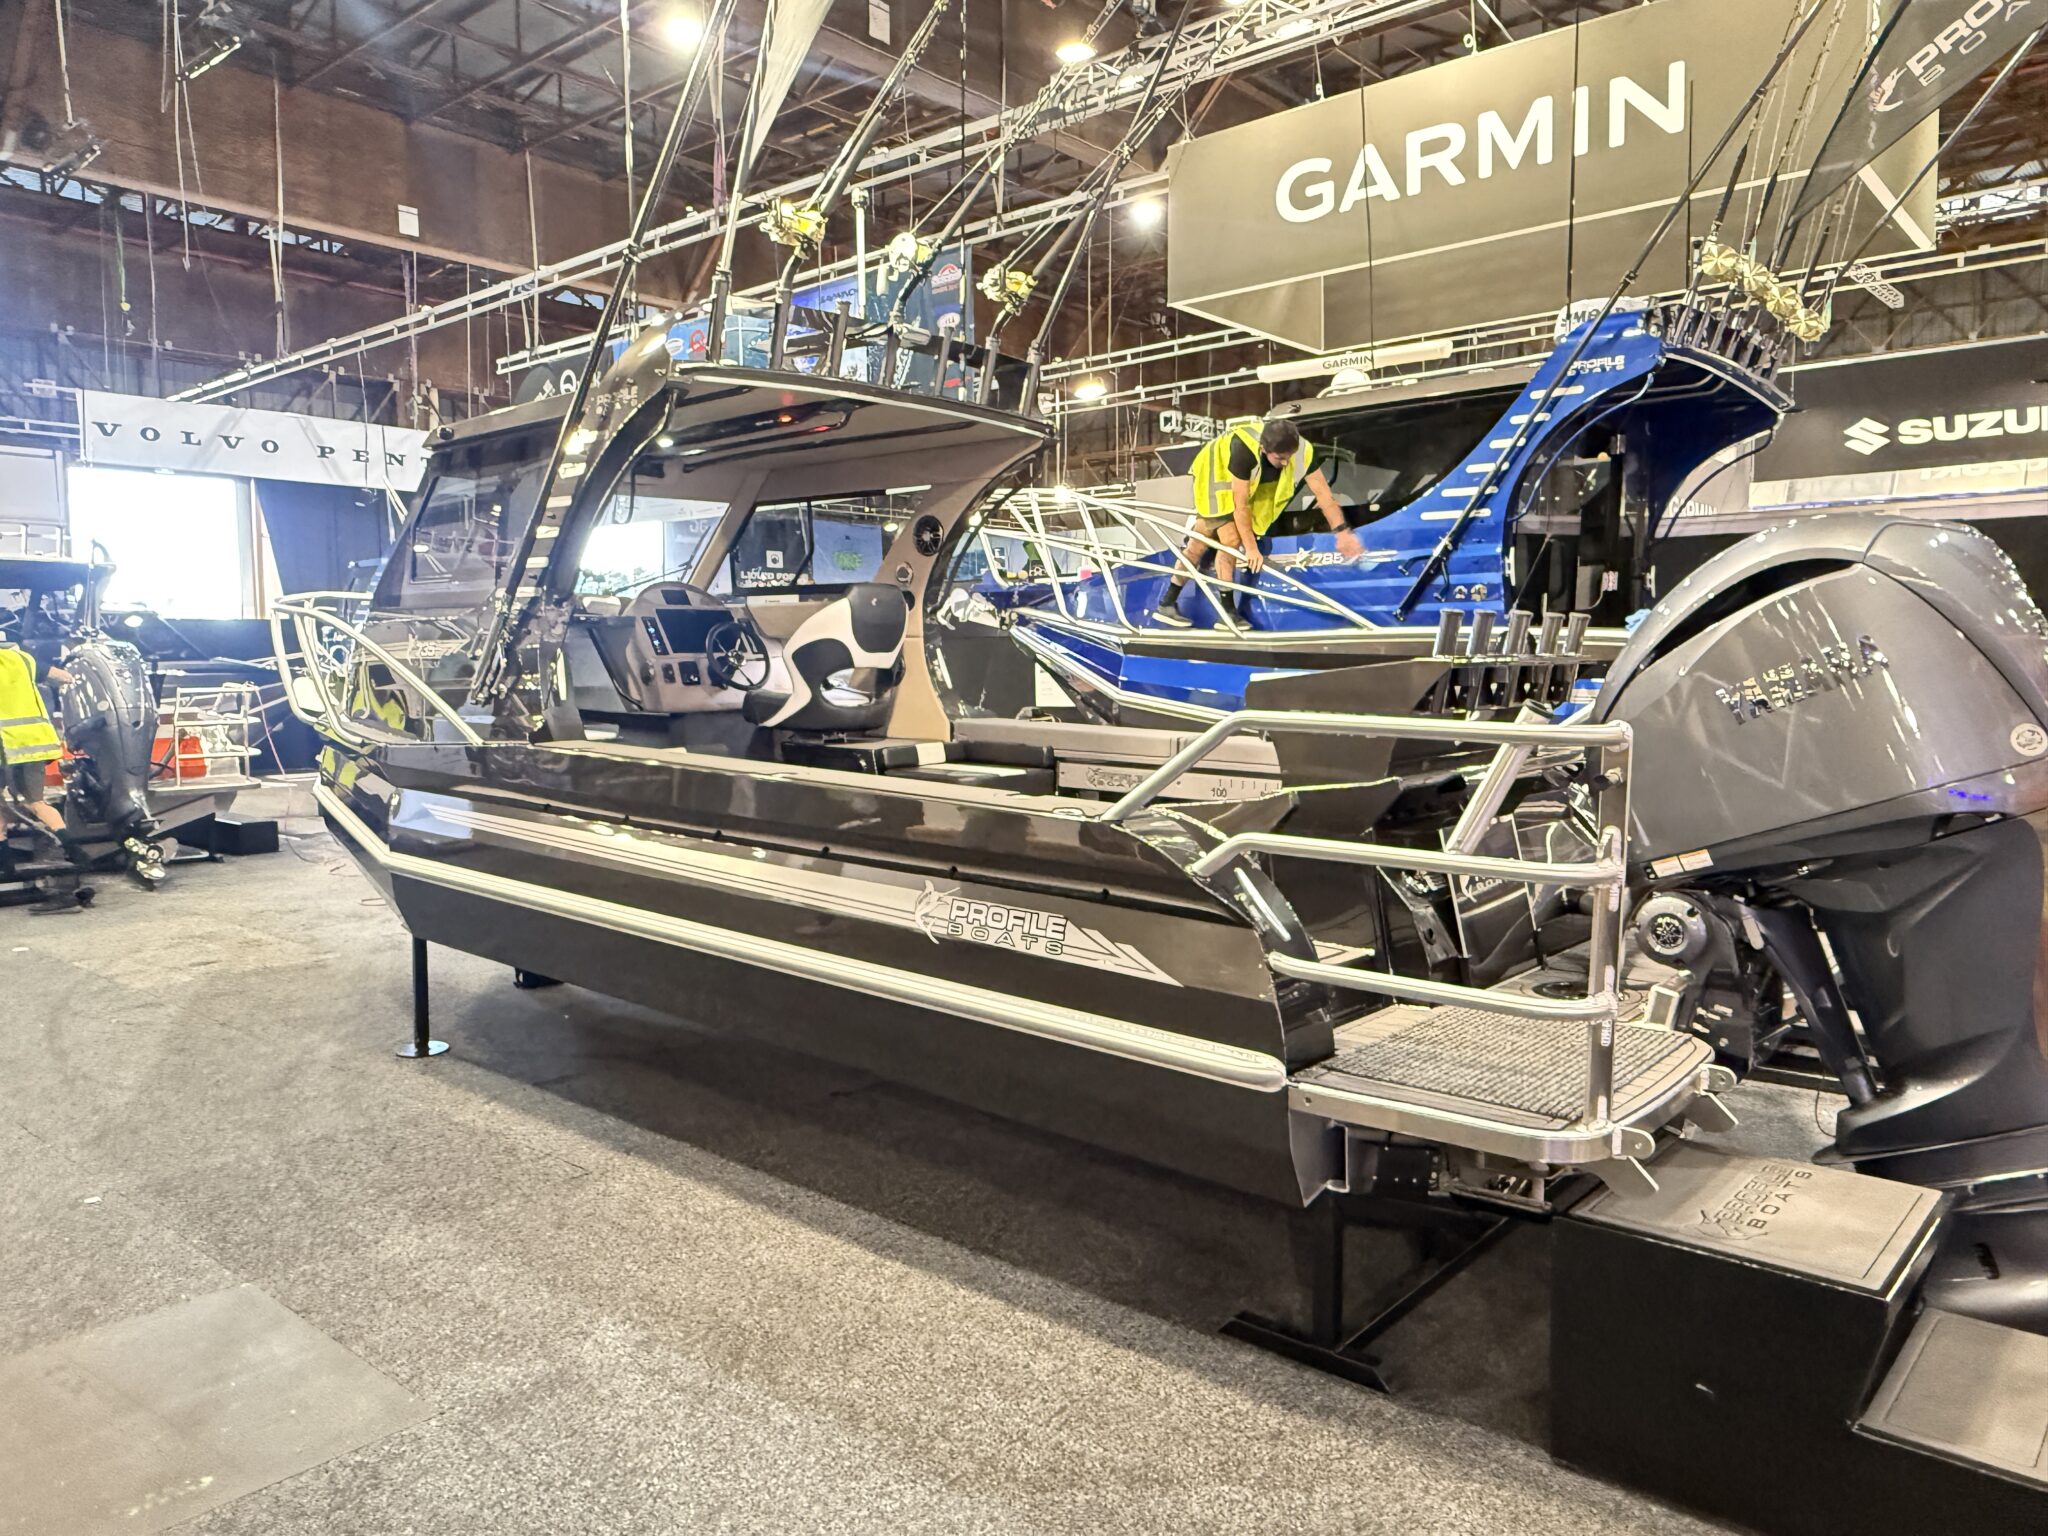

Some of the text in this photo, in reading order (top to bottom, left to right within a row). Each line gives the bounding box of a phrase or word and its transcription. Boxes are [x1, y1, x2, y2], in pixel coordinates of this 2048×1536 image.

[1275, 60, 1686, 223] GARMIN
[1322, 355, 1374, 370] GARMIN
[92, 421, 279, 454] VOLVO
[1898, 405, 2048, 445] SUZU
[947, 921, 1063, 956] BOATS
[950, 898, 1068, 941] PROFILE
[1746, 1170, 1813, 1229] BOATS
